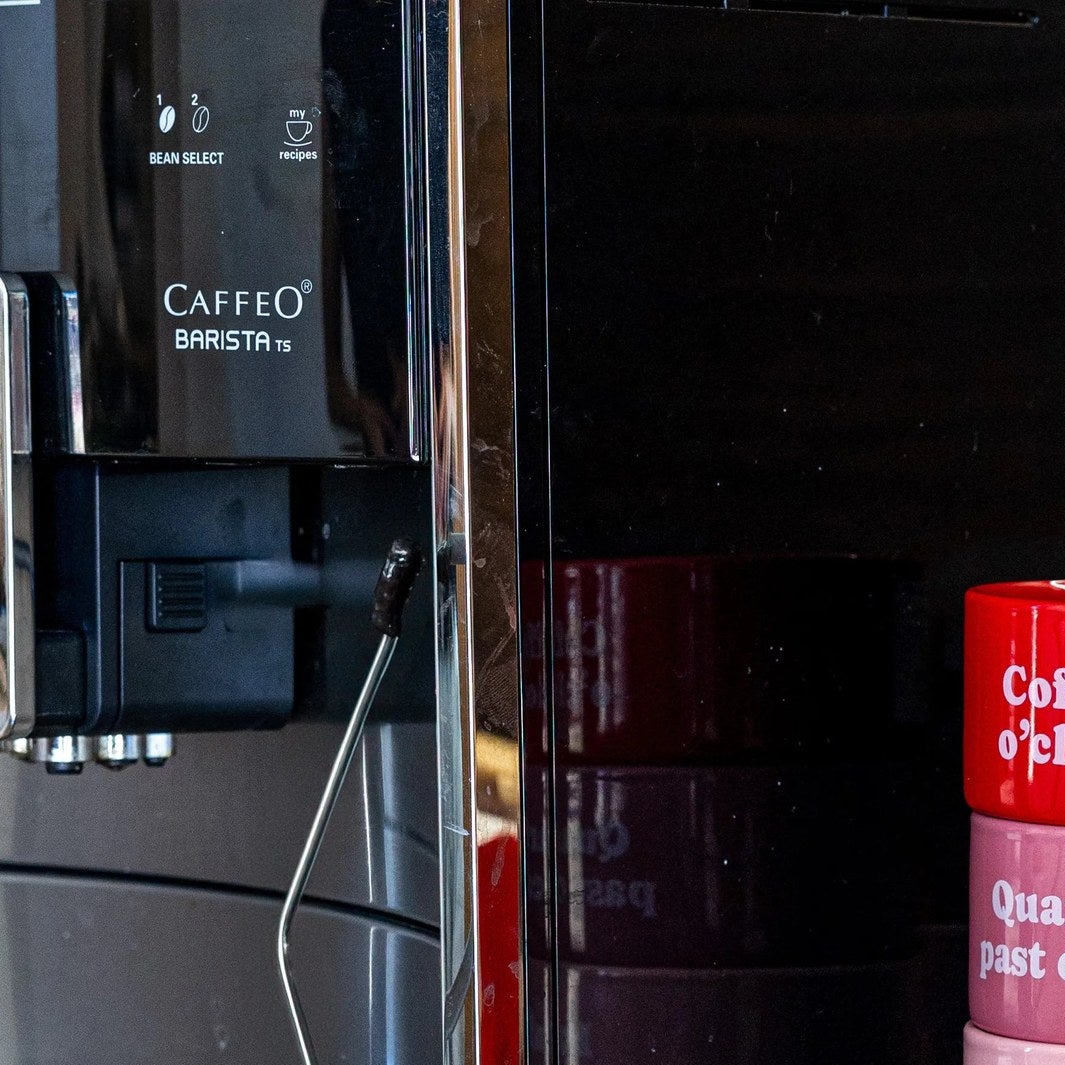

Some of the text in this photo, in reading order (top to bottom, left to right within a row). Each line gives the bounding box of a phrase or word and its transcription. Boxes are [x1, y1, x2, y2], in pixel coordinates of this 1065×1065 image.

[156, 93, 162, 106] 1
[191, 93, 199, 106] 2
[289, 108, 306, 118] my
[150, 152, 224, 165] BEAN SELECT
[279, 149, 318, 162] recipes
[175, 328, 292, 352] BARISTA TS
[979, 939, 1046, 979] past
